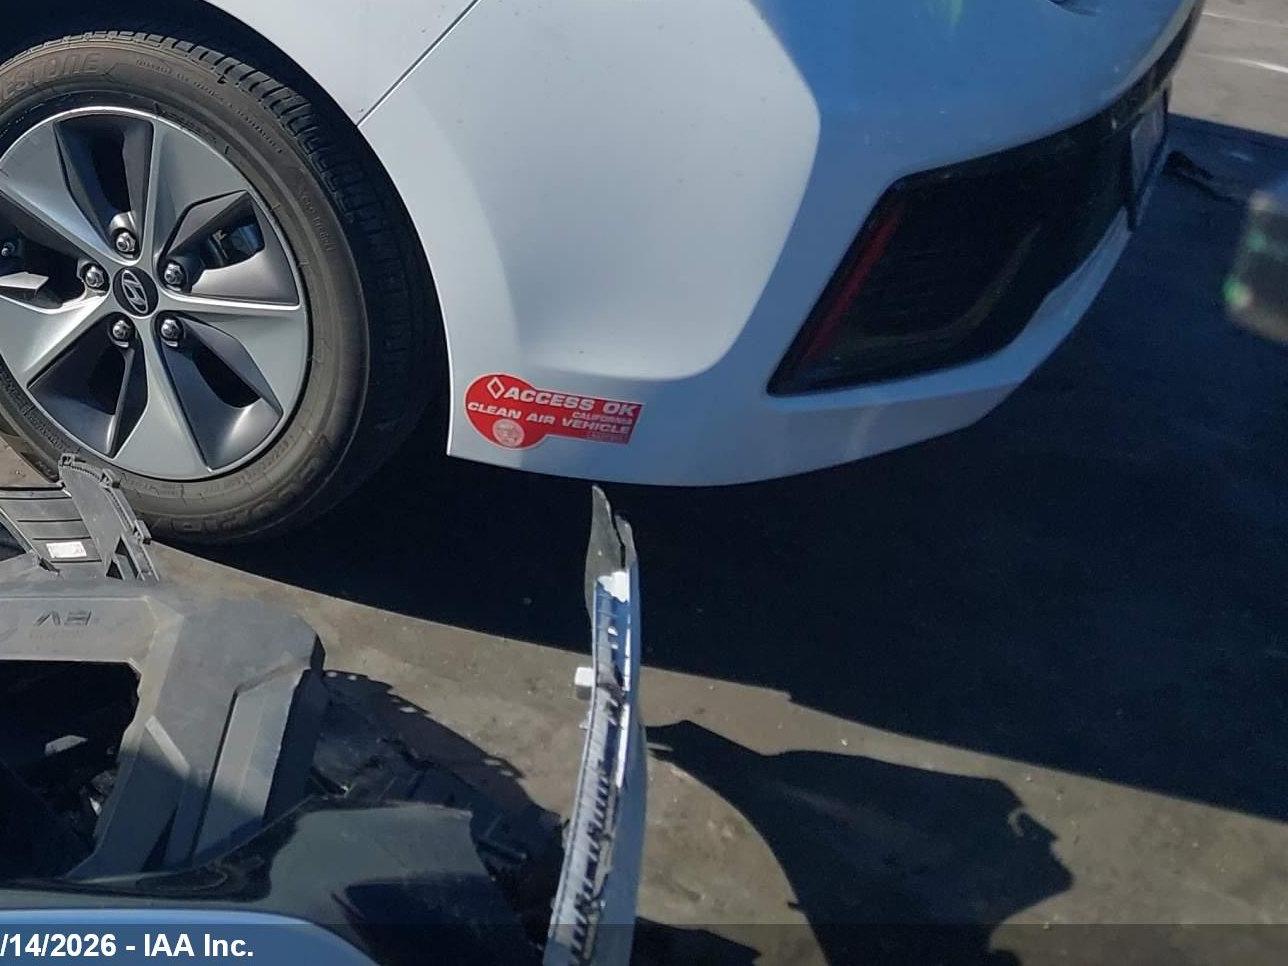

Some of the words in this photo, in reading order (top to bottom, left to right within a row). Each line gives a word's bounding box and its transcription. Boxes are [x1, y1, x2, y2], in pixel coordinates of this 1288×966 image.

[468, 401, 522, 420] CLEAN
[526, 412, 556, 426] AIR
[562, 417, 630, 434] VEHICLE
[504, 387, 595, 411] ACCESS
[602, 401, 639, 417] OK
